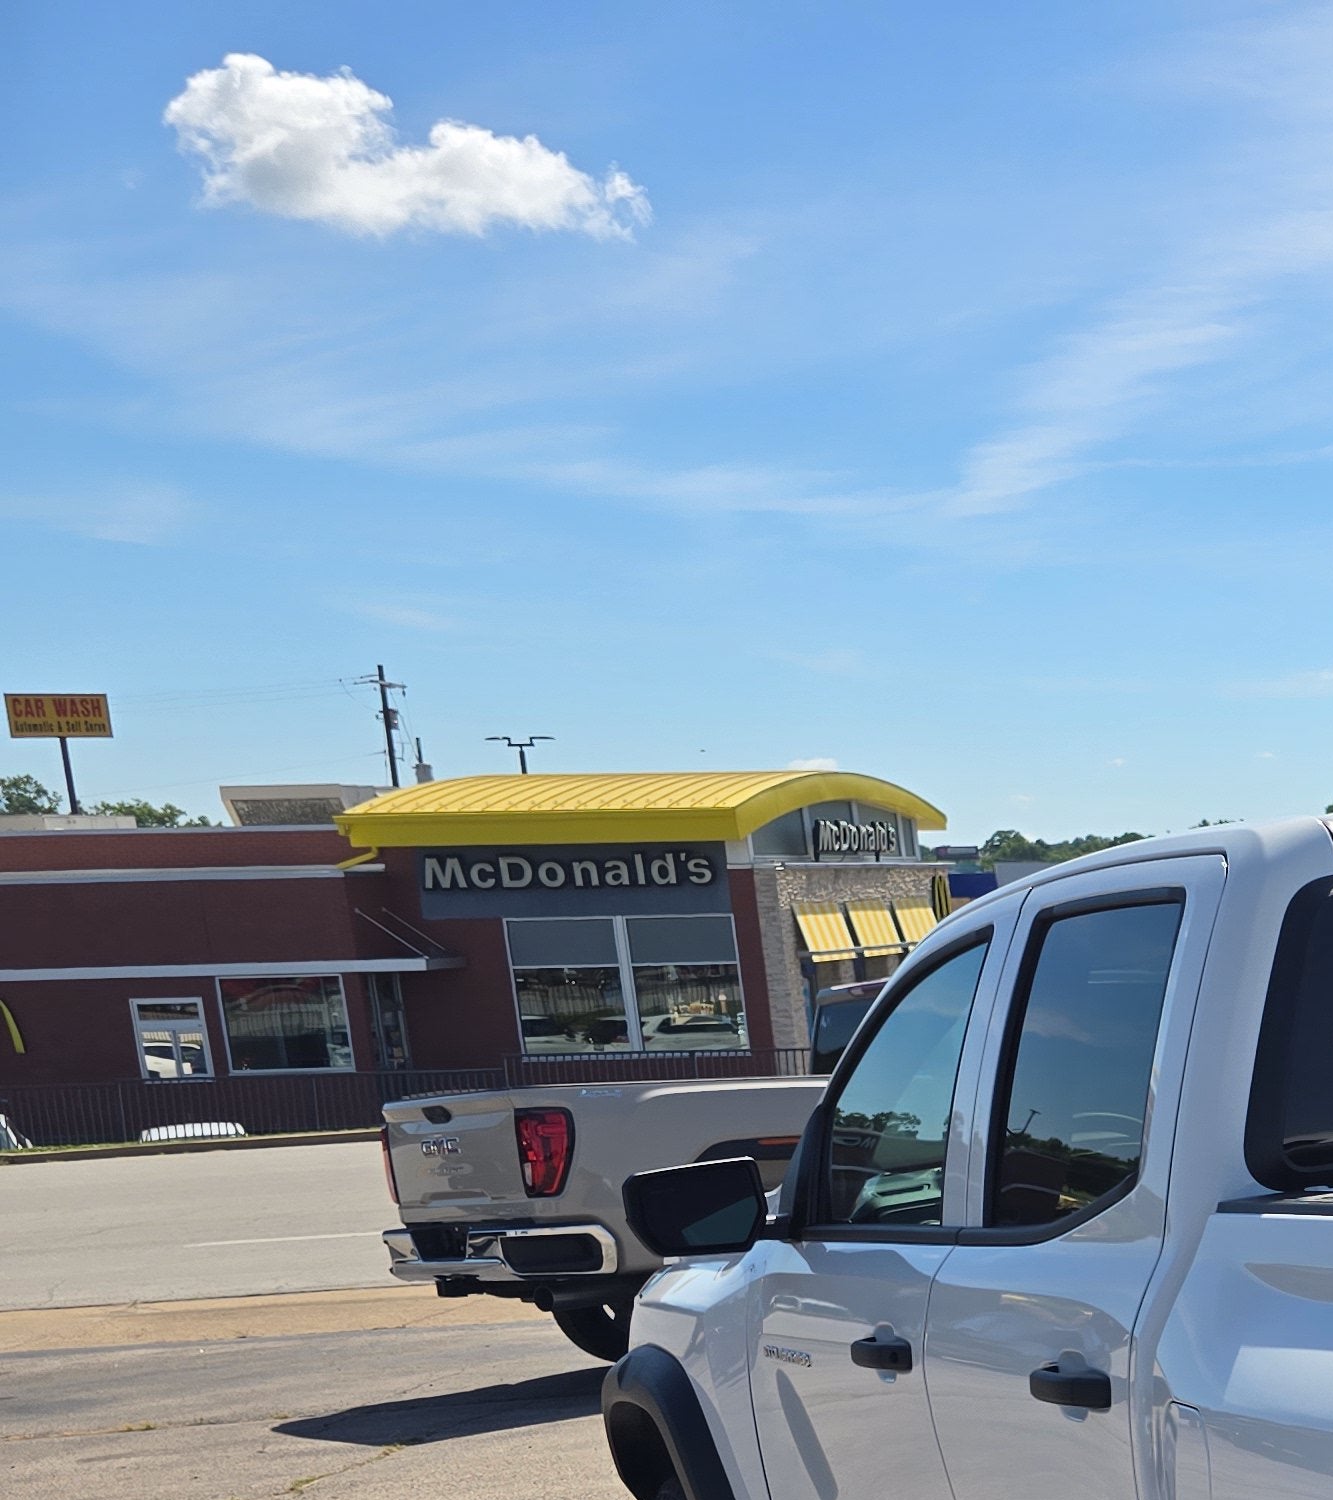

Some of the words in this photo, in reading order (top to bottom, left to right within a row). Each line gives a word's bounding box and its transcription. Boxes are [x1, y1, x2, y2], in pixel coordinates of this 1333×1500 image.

[11, 697, 46, 718] CAR
[53, 697, 102, 718] WASH
[818, 820, 897, 852] McDonald's
[424, 852, 713, 889] McDonald's
[420, 1137, 463, 1157] GMC
